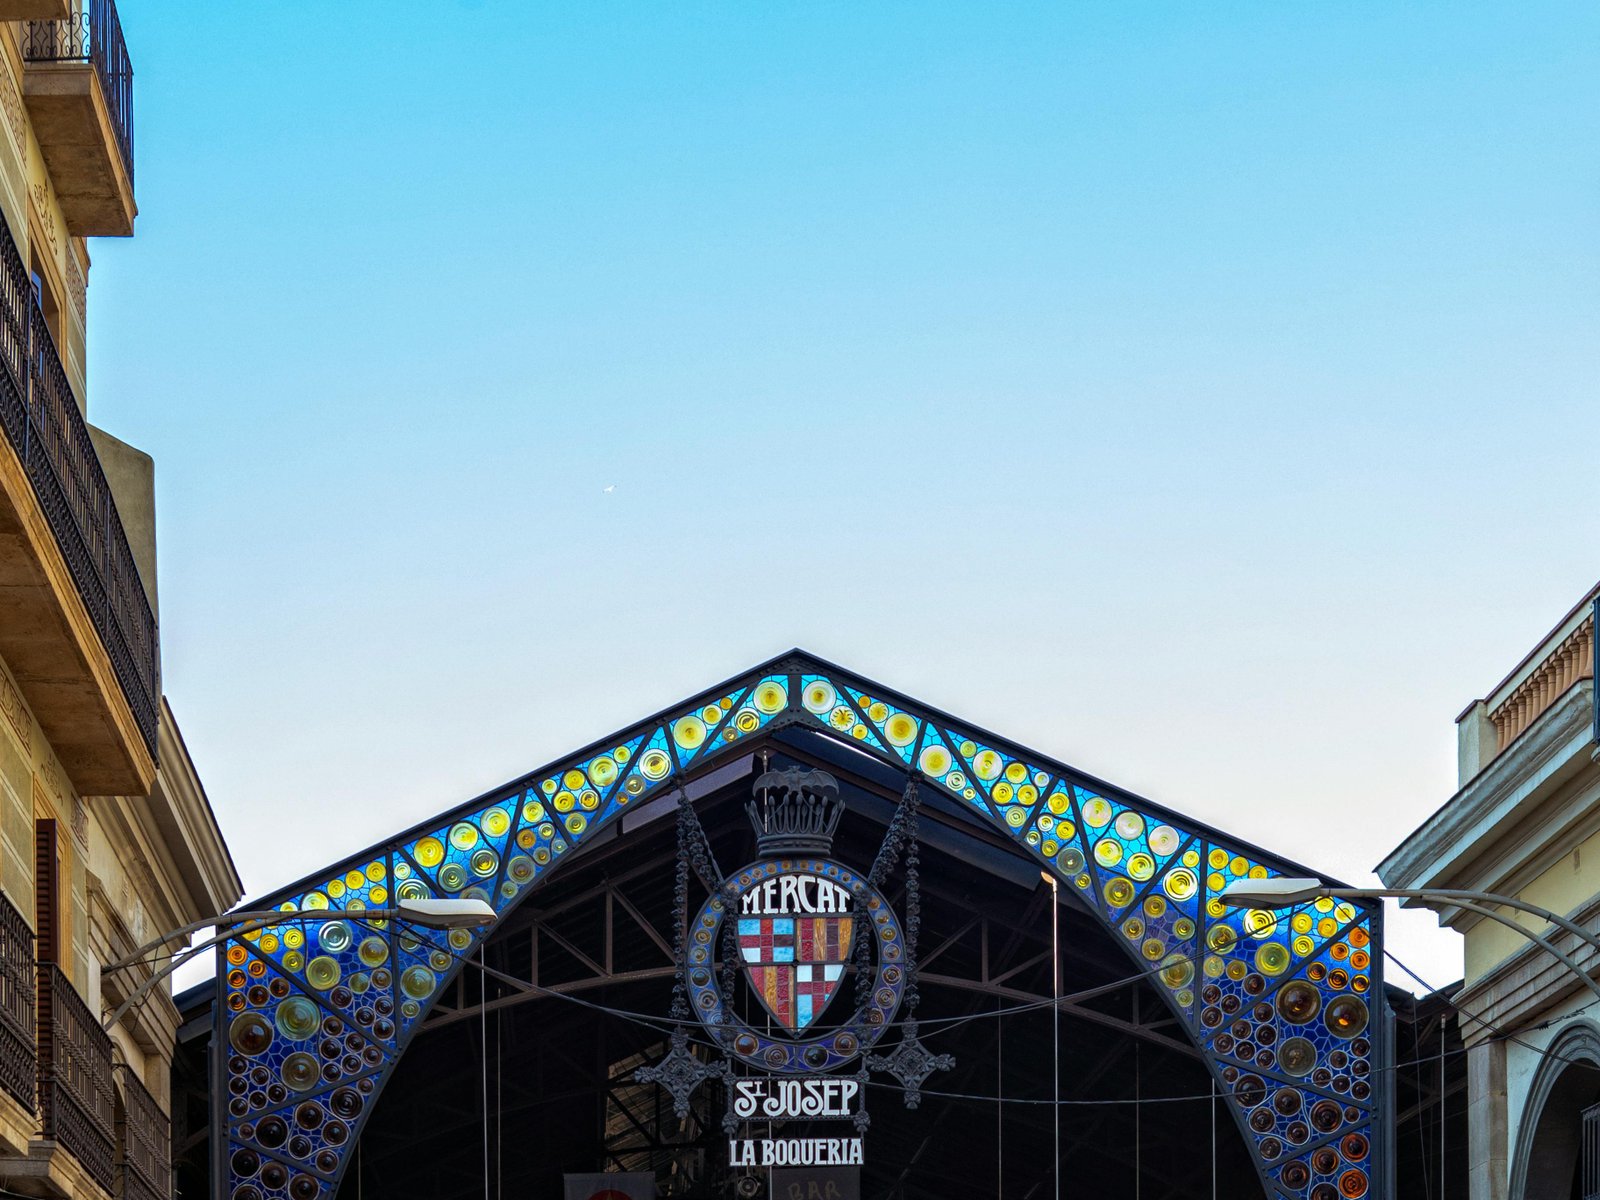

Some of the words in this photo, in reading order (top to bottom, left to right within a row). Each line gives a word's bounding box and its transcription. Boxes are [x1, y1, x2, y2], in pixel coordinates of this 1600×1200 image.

[742, 875, 850, 914] MERCAT
[763, 1080, 858, 1117] JOSEP
[730, 1140, 756, 1166] LA
[762, 1138, 864, 1166] BOQUERIA
